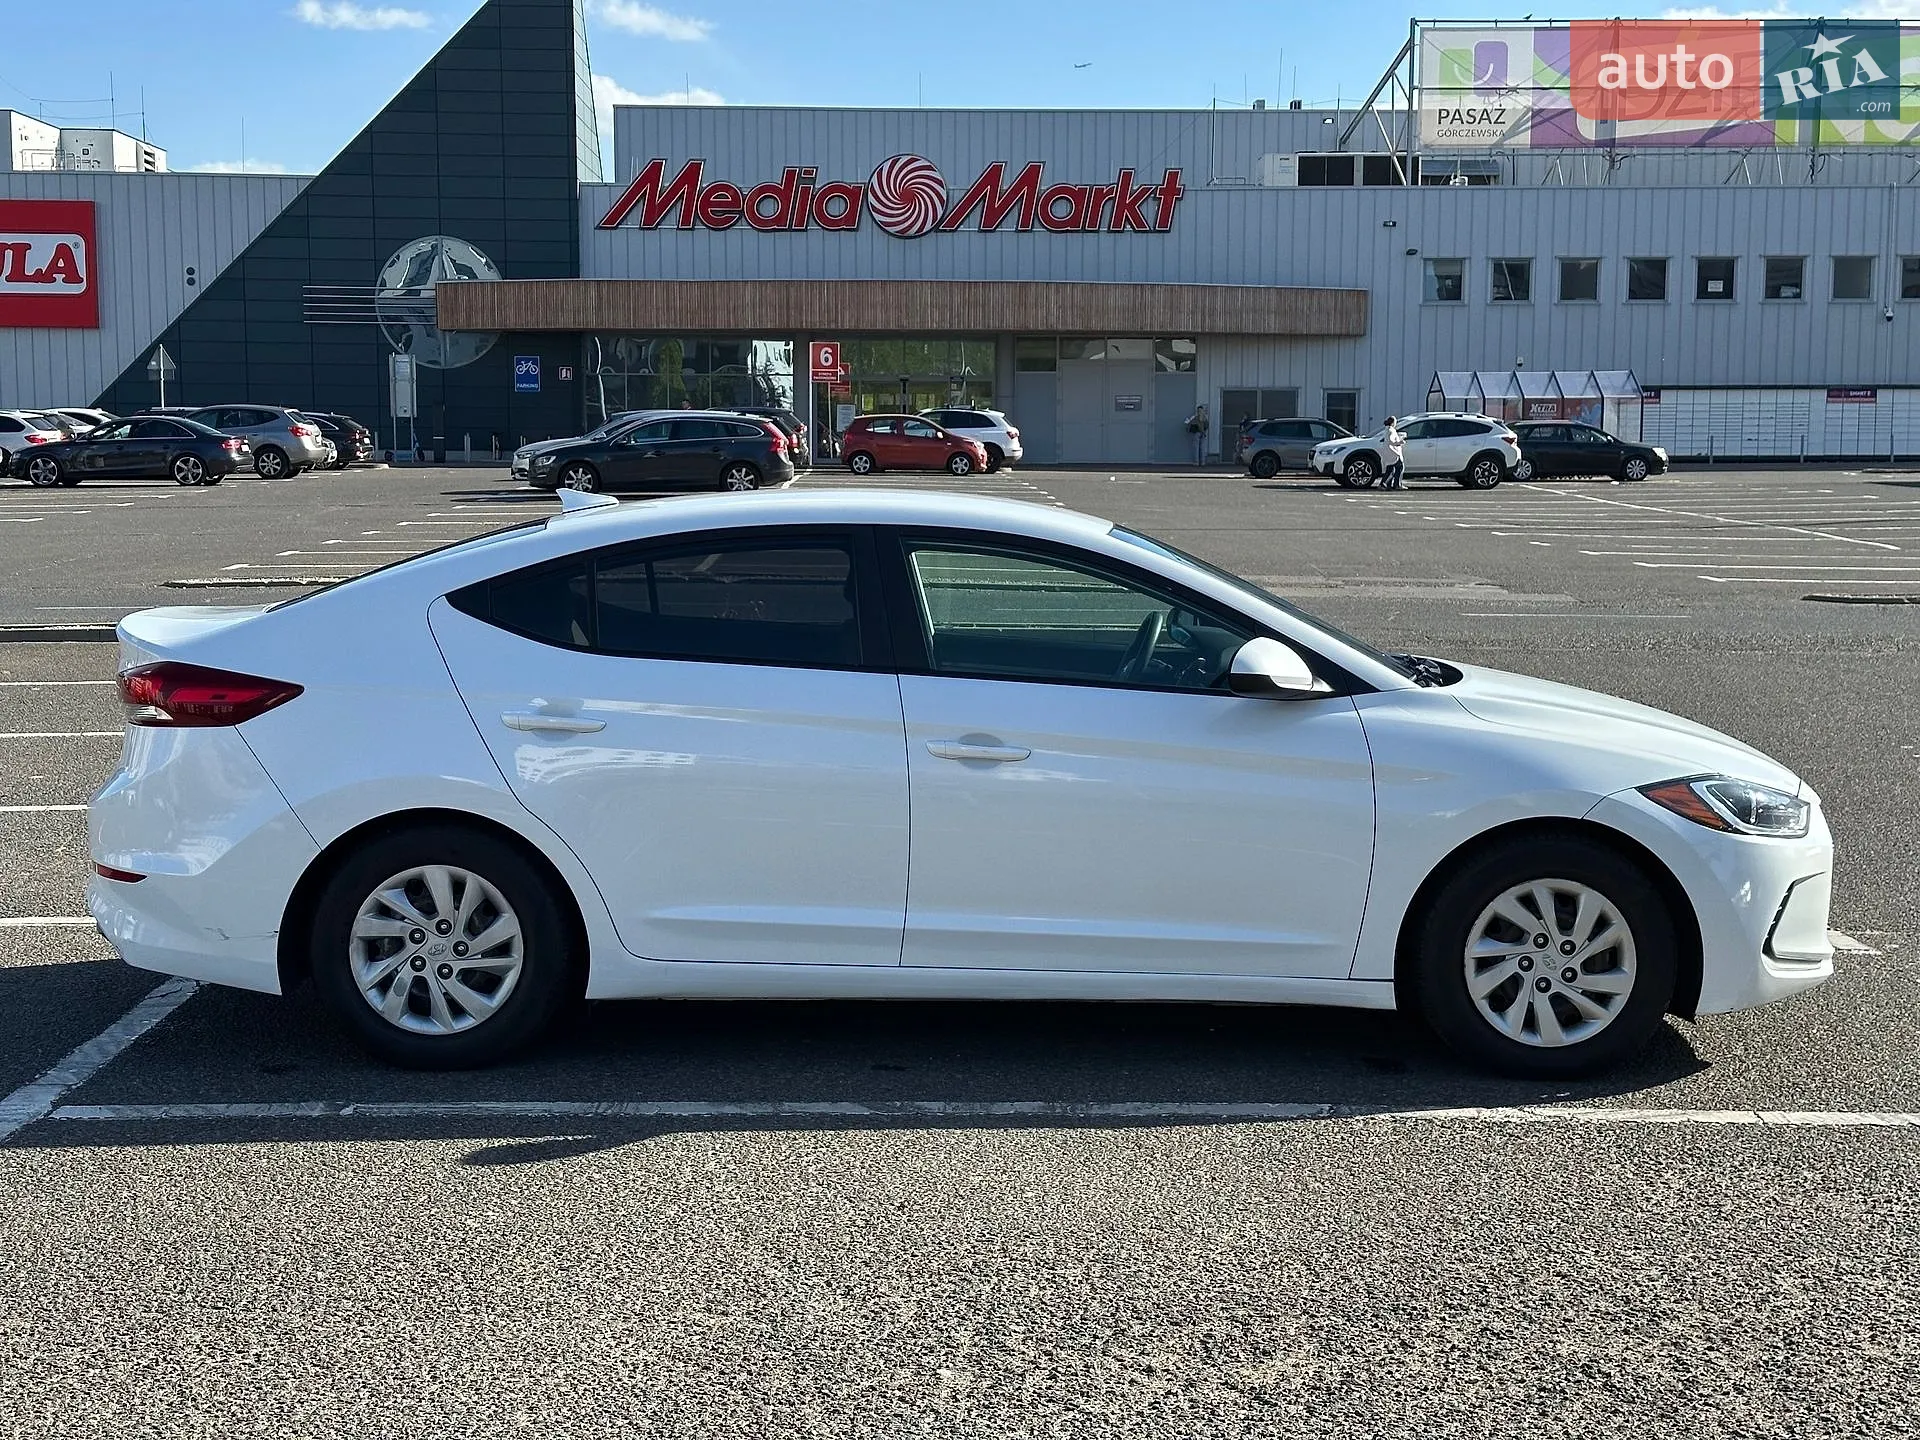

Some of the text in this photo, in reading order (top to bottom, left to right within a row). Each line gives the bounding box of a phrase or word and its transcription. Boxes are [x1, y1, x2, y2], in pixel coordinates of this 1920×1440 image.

[1438, 104, 1506, 124] PASAŻ
[1437, 128, 1505, 138] GÓRCZEWSKA
[597, 158, 1185, 233] Media Markt
[820, 346, 833, 367] 6
